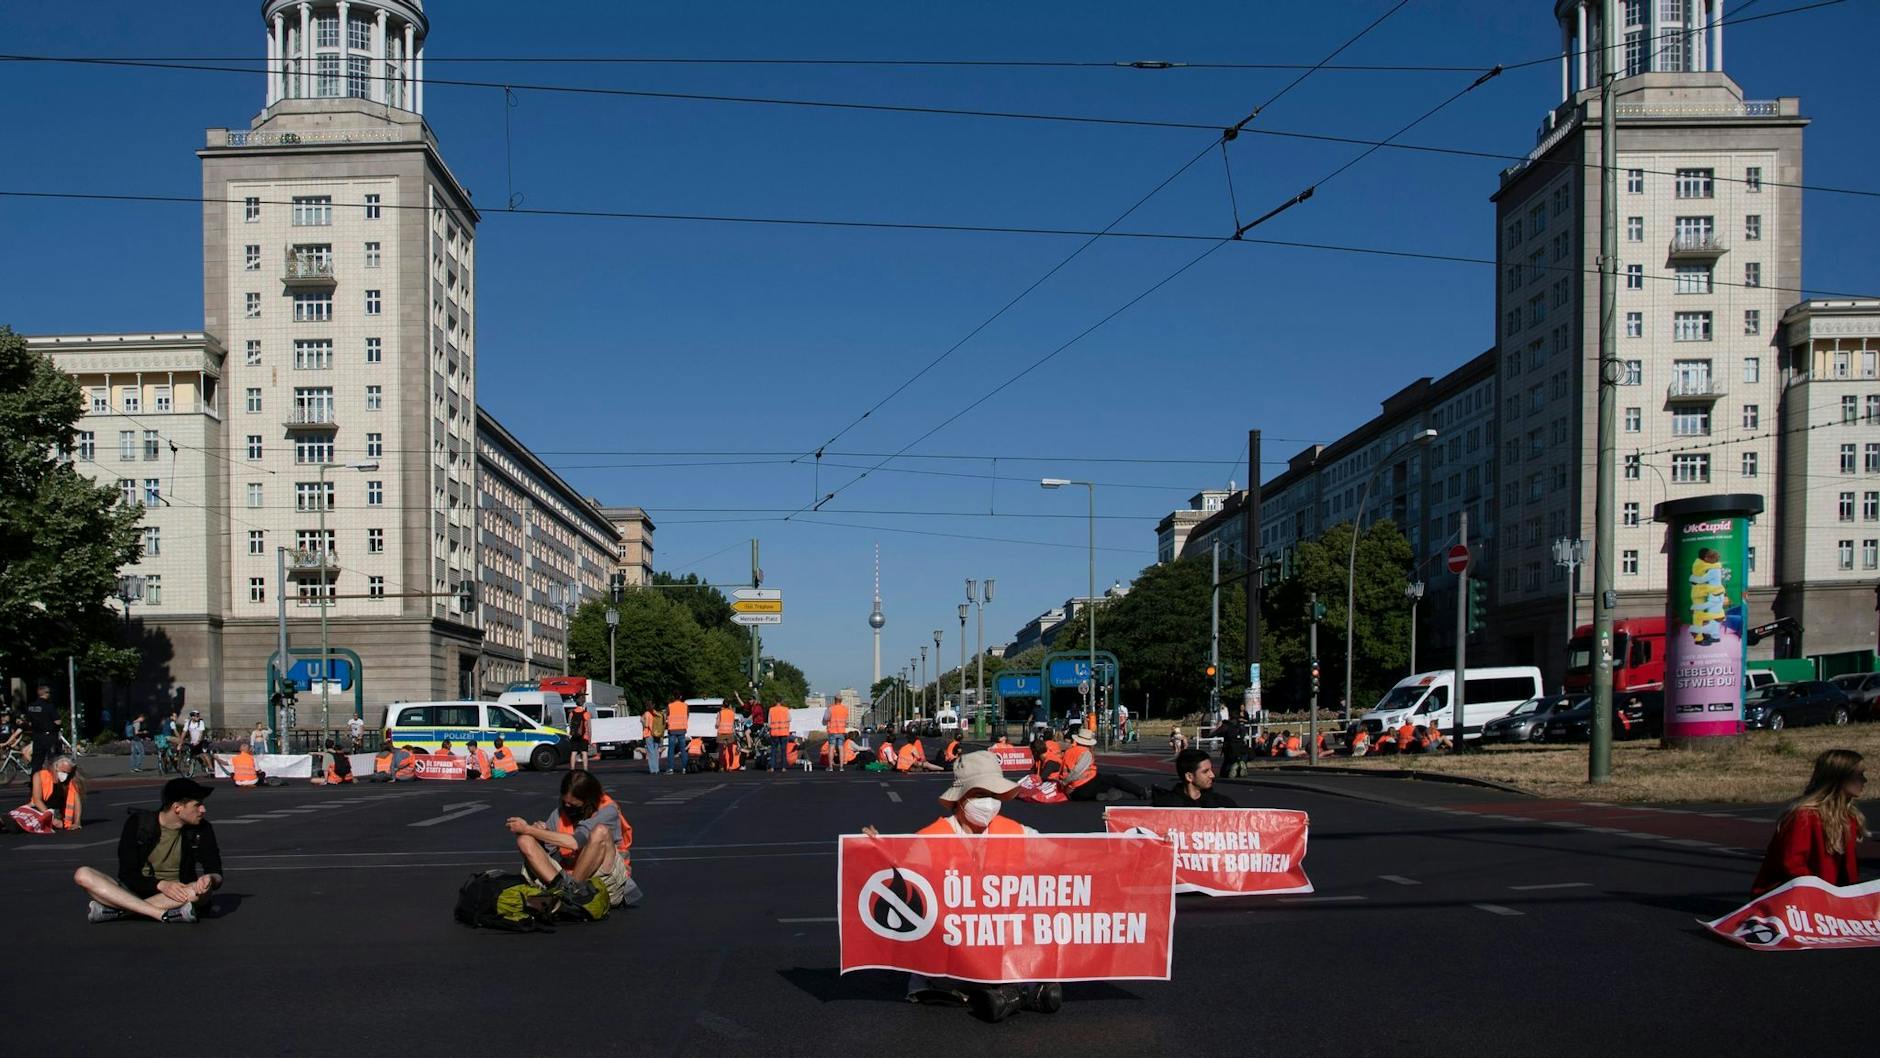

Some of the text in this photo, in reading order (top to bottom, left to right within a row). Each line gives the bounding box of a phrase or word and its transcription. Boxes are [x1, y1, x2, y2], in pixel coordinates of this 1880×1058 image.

[307, 663, 320, 678] U
[1676, 666, 1734, 678] LIEBEVOLL
[1017, 678, 1025, 689] U
[1691, 677, 1715, 688] WIE
[1716, 677, 1737, 688] DU!
[444, 732, 475, 741] POLIZEI
[1191, 831, 1261, 851] SPAREN
[1224, 853, 1291, 873] BOHREN
[944, 869, 1092, 908] ÖL SPAREN
[1785, 905, 1814, 933] ÖL
[943, 912, 1147, 946] STATT BOHREN
